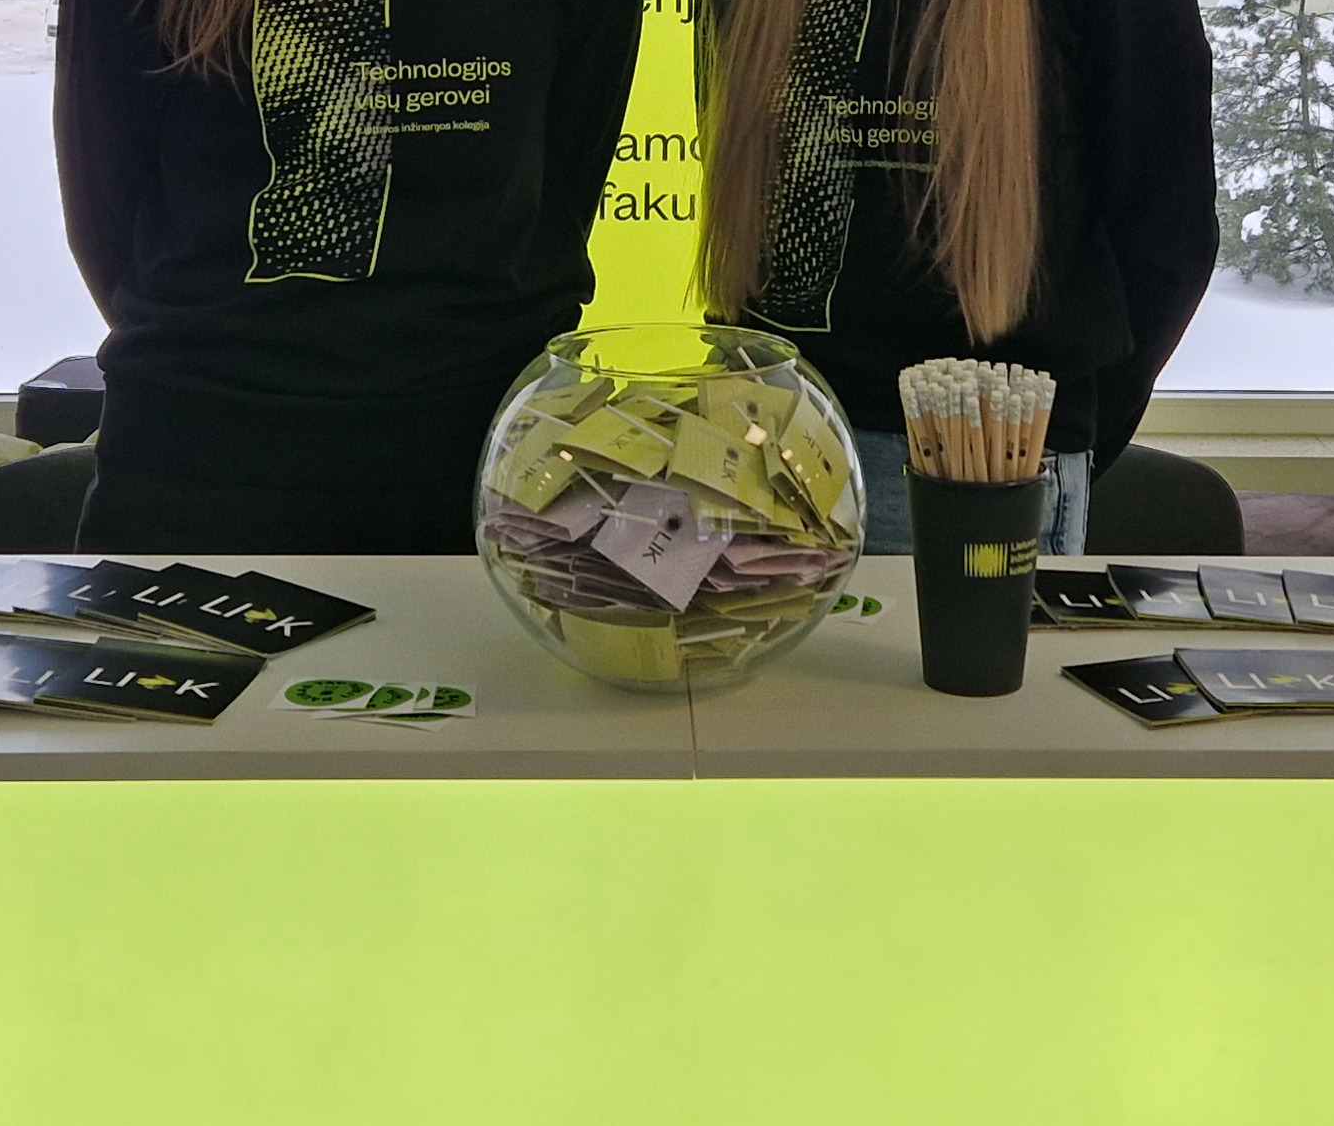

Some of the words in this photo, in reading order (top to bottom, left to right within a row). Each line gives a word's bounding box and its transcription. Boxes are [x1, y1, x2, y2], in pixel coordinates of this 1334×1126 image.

[351, 56, 512, 82] Technologijos
[356, 91, 401, 113] visų
[406, 84, 491, 113] gerovei
[867, 127, 941, 148] gerovei
[642, 530, 673, 565] LIK
